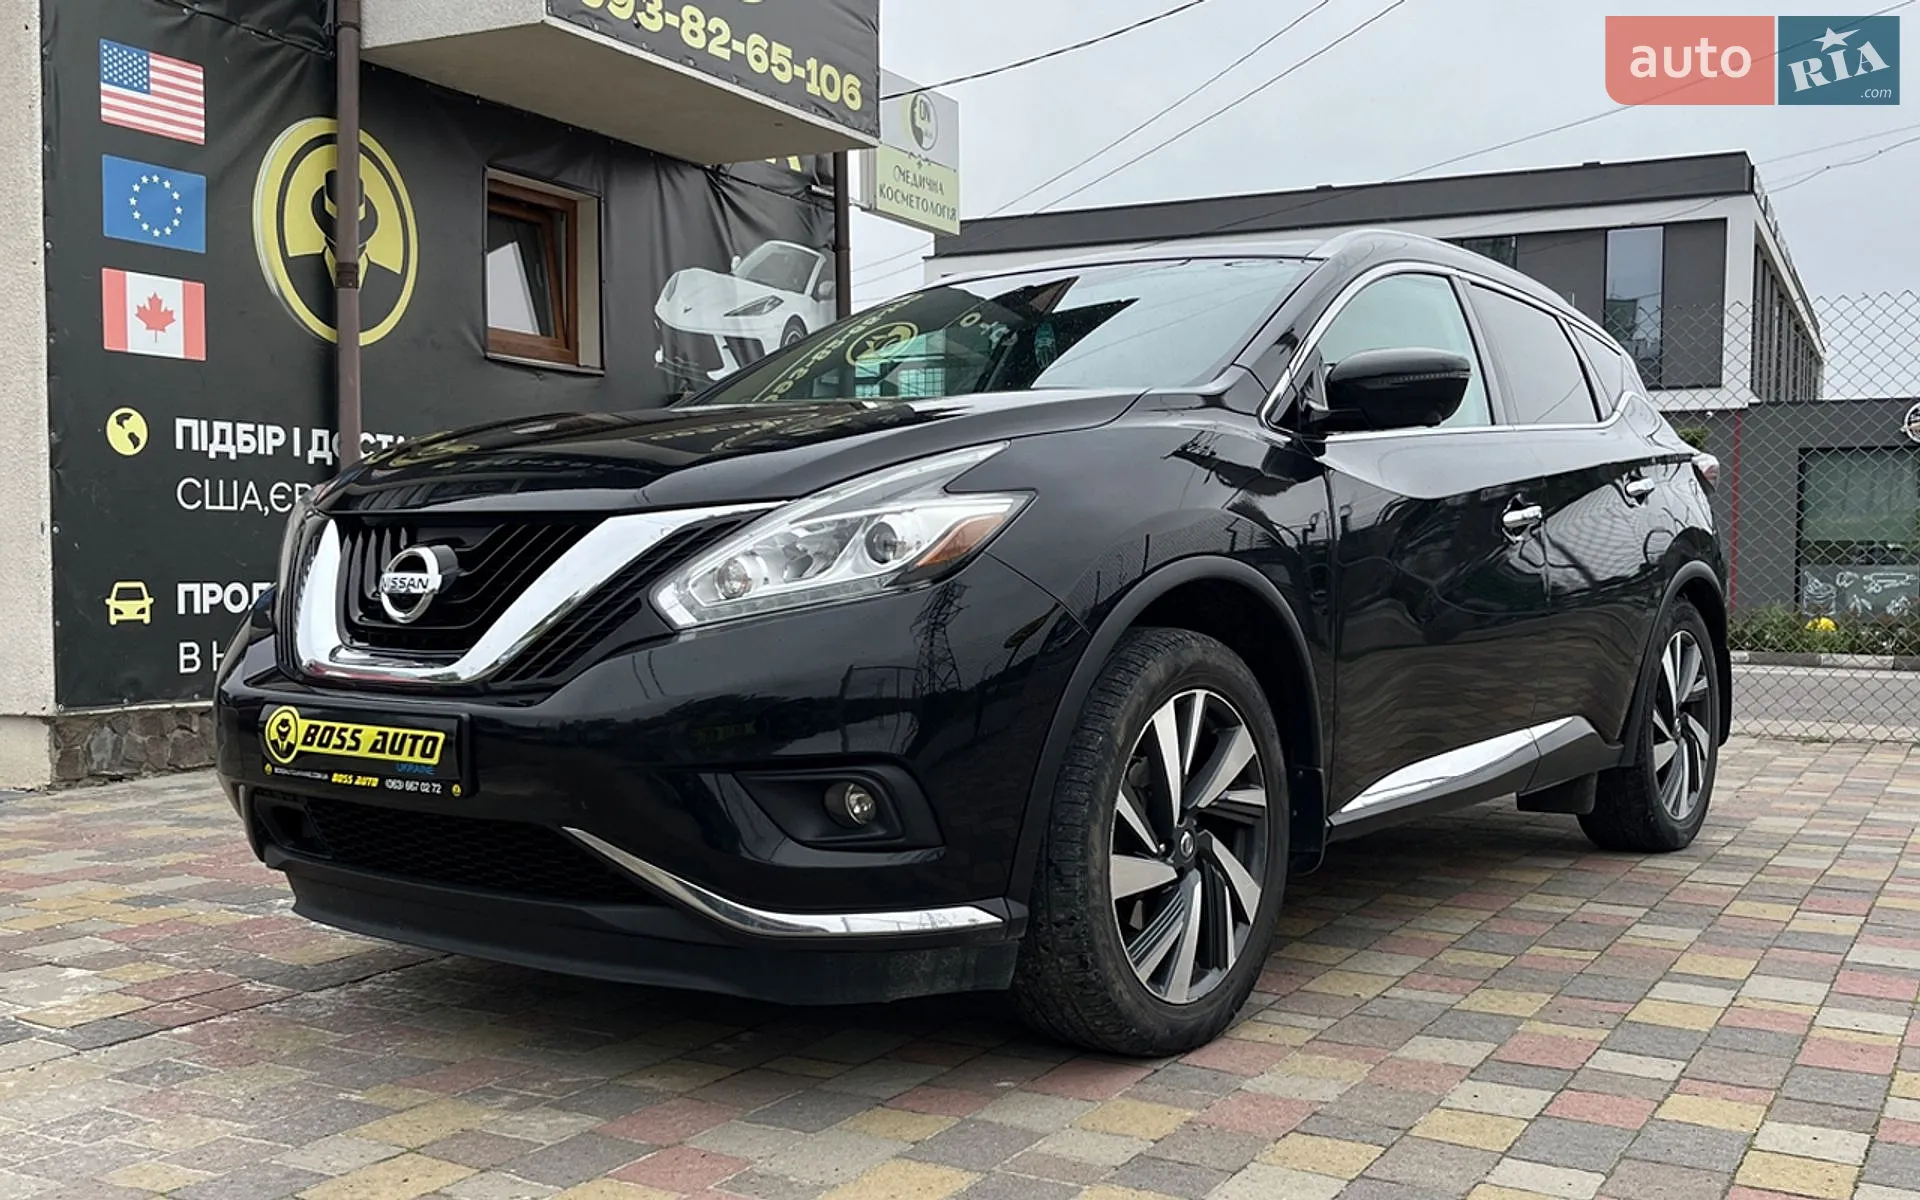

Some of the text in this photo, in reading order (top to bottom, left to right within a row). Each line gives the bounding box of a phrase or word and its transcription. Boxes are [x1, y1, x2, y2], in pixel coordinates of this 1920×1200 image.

[581, 0, 863, 111] 3-82-65-106
[175, 417, 406, 466] ПІДБІР І ДСТ
[381, 576, 429, 592] NISSAN
[179, 641, 201, 674] В
[301, 724, 440, 759] BOSS AUTO
[331, 773, 353, 785] BOSS
[354, 776, 380, 788] AUTO
